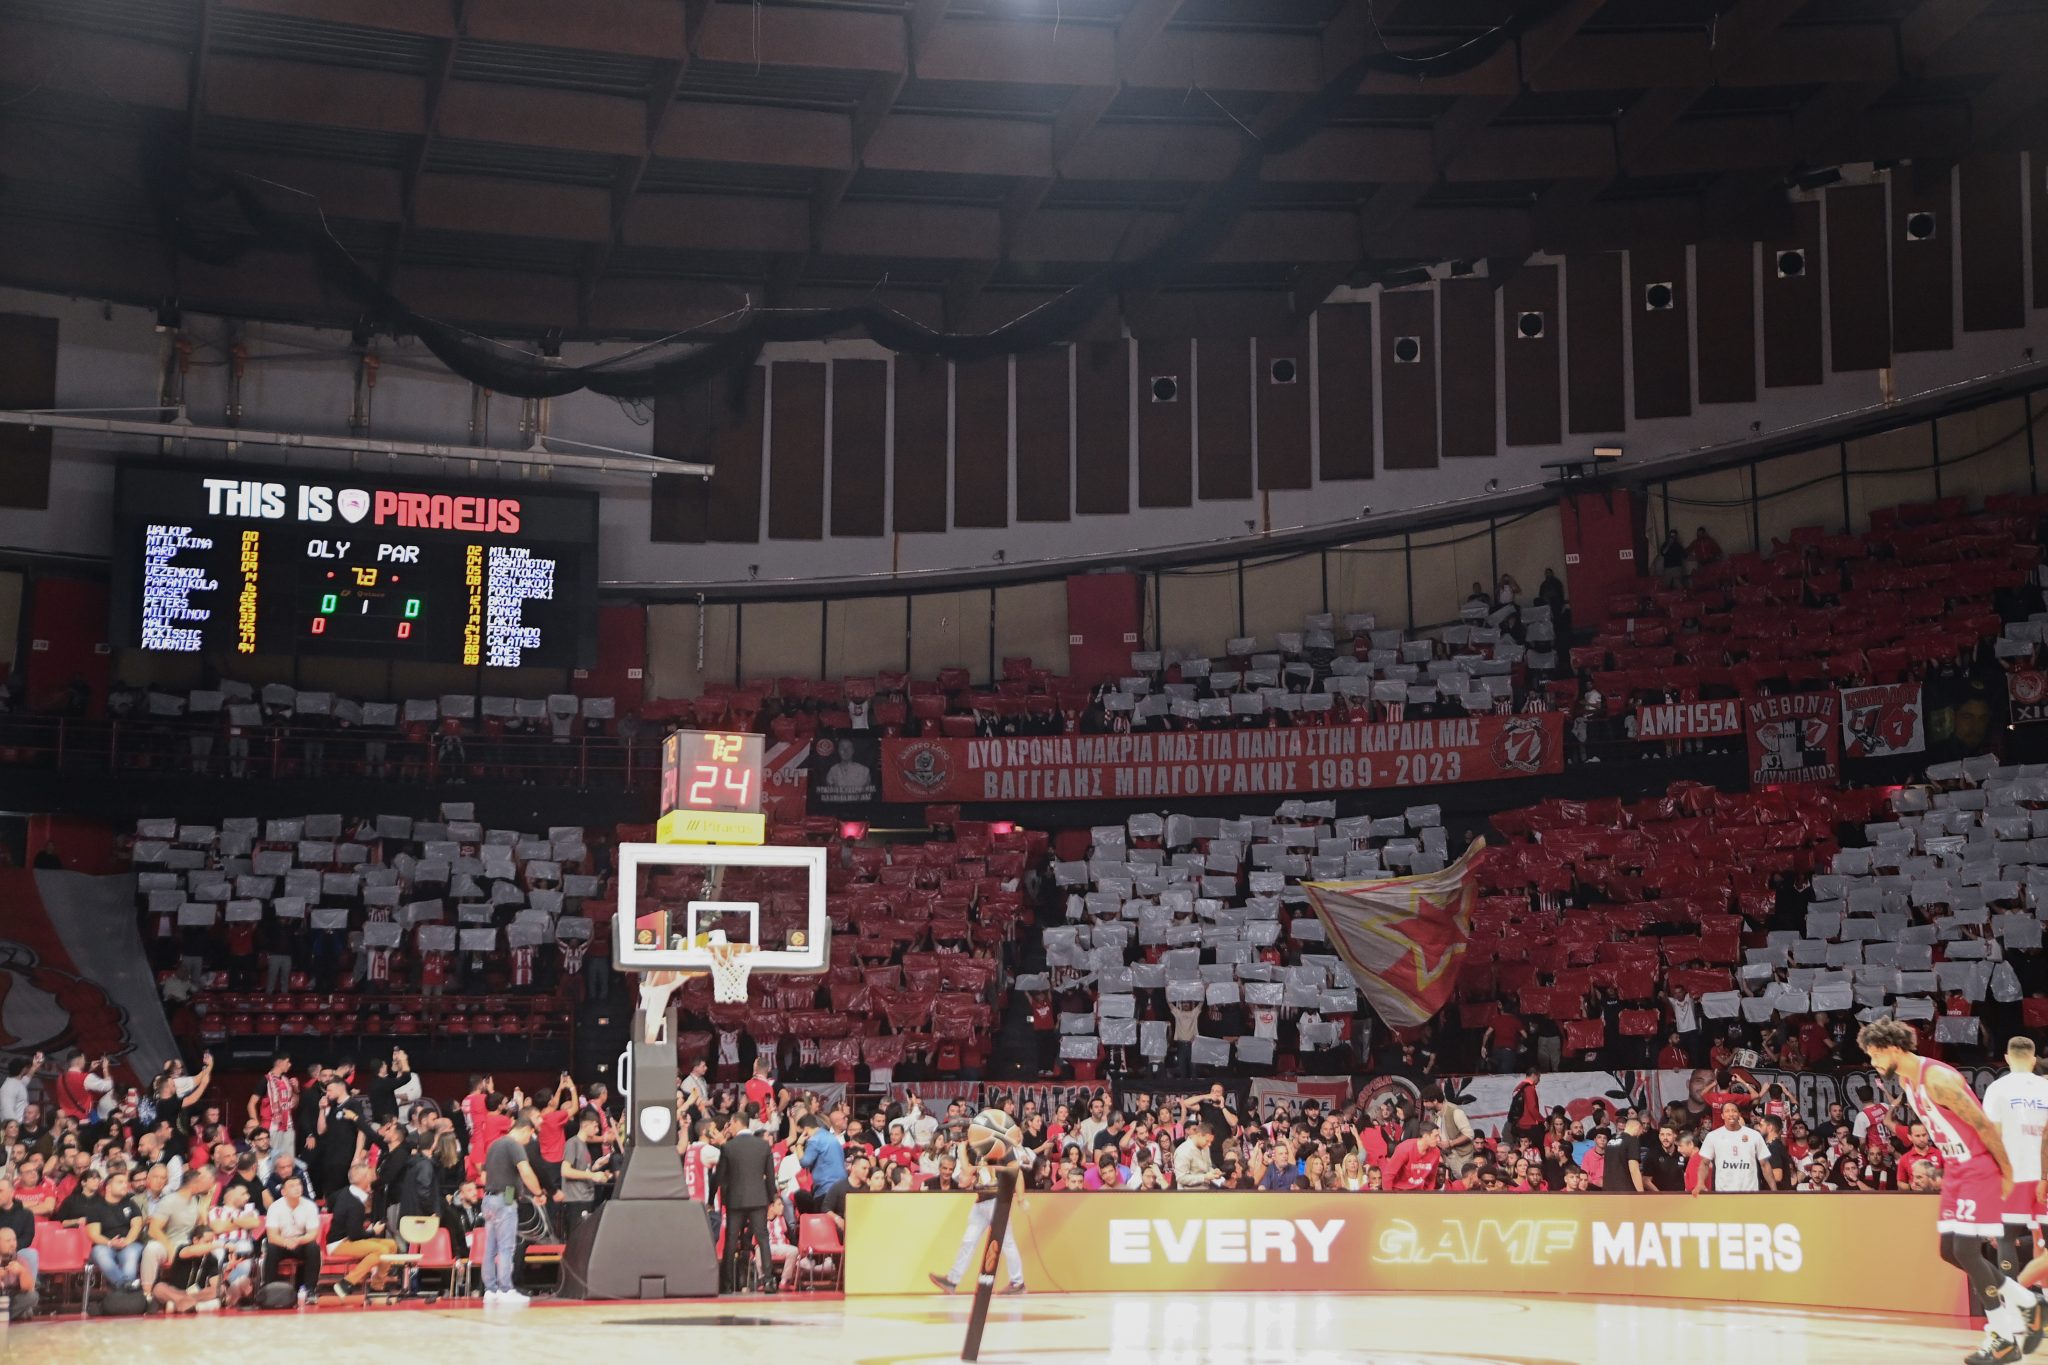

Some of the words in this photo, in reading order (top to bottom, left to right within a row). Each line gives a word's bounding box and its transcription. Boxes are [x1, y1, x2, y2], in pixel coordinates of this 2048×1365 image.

[203, 479, 285, 519] THIS
[298, 485, 333, 521] IS
[146, 525, 192, 536] WALKUP
[242, 531, 259, 541] 00
[146, 535, 213, 549] NTILIKINA
[242, 541, 259, 551] 01
[145, 546, 177, 556] WARD
[241, 551, 258, 562] 03
[307, 540, 351, 559] OLY
[377, 544, 420, 563] PAR
[467, 545, 482, 556] 02
[489, 546, 530, 559] MILTON
[145, 556, 169, 566] LEE
[241, 561, 258, 572] 09
[466, 555, 482, 565] 04
[488, 557, 556, 570] WASHINGTON
[245, 572, 257, 582] 14
[466, 565, 481, 575] 05
[488, 567, 554, 579] OSETKOWSKI
[144, 577, 219, 591] PAPANIKOLA
[244, 582, 256, 592] 16
[466, 575, 482, 585] 08
[144, 586, 190, 598] DORSEY
[240, 591, 257, 602] 22
[470, 585, 481, 595] 11
[143, 597, 189, 608] PETERS
[239, 602, 256, 612] 25
[321, 594, 337, 613] 0
[405, 599, 420, 618] 0
[470, 595, 481, 605] 12
[487, 596, 522, 607] BROWN
[239, 612, 256, 623] 33
[469, 605, 481, 614] 17
[487, 605, 521, 617] BONGA
[142, 618, 173, 629] HALL
[239, 622, 256, 633] 45
[312, 617, 326, 634] 0
[398, 622, 411, 638] 0
[469, 614, 480, 625] 19
[487, 615, 521, 627] LAKIC
[142, 628, 202, 640] MCKISSIC
[240, 632, 255, 643] 77
[464, 624, 480, 634] 24
[487, 626, 541, 638] FERNANDO
[141, 638, 202, 651] FOURNIER
[238, 642, 255, 653] 94
[465, 634, 480, 645] 33
[487, 636, 541, 648] CALATHES
[464, 644, 480, 655] 88
[486, 646, 520, 656] JONES
[463, 654, 479, 665] 88
[486, 655, 520, 667] JONES
[1749, 695, 1834, 723] ΜΕΘΩΝΗ
[1640, 701, 1739, 736] AMFISSA
[967, 739, 1001, 769] ΔΥΟ
[1007, 736, 1073, 767] ΧΡΟΝΙΑ
[1076, 735, 1154, 764] ΜΑΚΡΙΑ
[1158, 733, 1198, 762] ΜΑΣ
[1203, 732, 1233, 760] ΓΙΑ
[1237, 730, 1301, 759] ΠΑΝΤΑ
[1306, 728, 1355, 756] ΣΤΗΝ
[1361, 723, 1434, 753] ΚΑΡΔΙΑ
[1438, 719, 1480, 747] ΜΑΣ
[984, 768, 1103, 799] ΒΑΓΓΕΛΗΣ
[1115, 761, 1297, 796] ΜΠΑΓΟΥΡΑΚΗΣ
[1308, 758, 1373, 789] 1989
[1395, 752, 1462, 785] 2023
[1753, 763, 1836, 784] ΟΛΥΜΠΙΑΚΟΣ
[689, 765, 750, 805] 24
[1722, 1160, 1750, 1170] bwin
[1956, 1199, 1976, 1221] 22
[1109, 1219, 1346, 1263] EVERY
[1592, 1221, 1803, 1273] MATTERS
